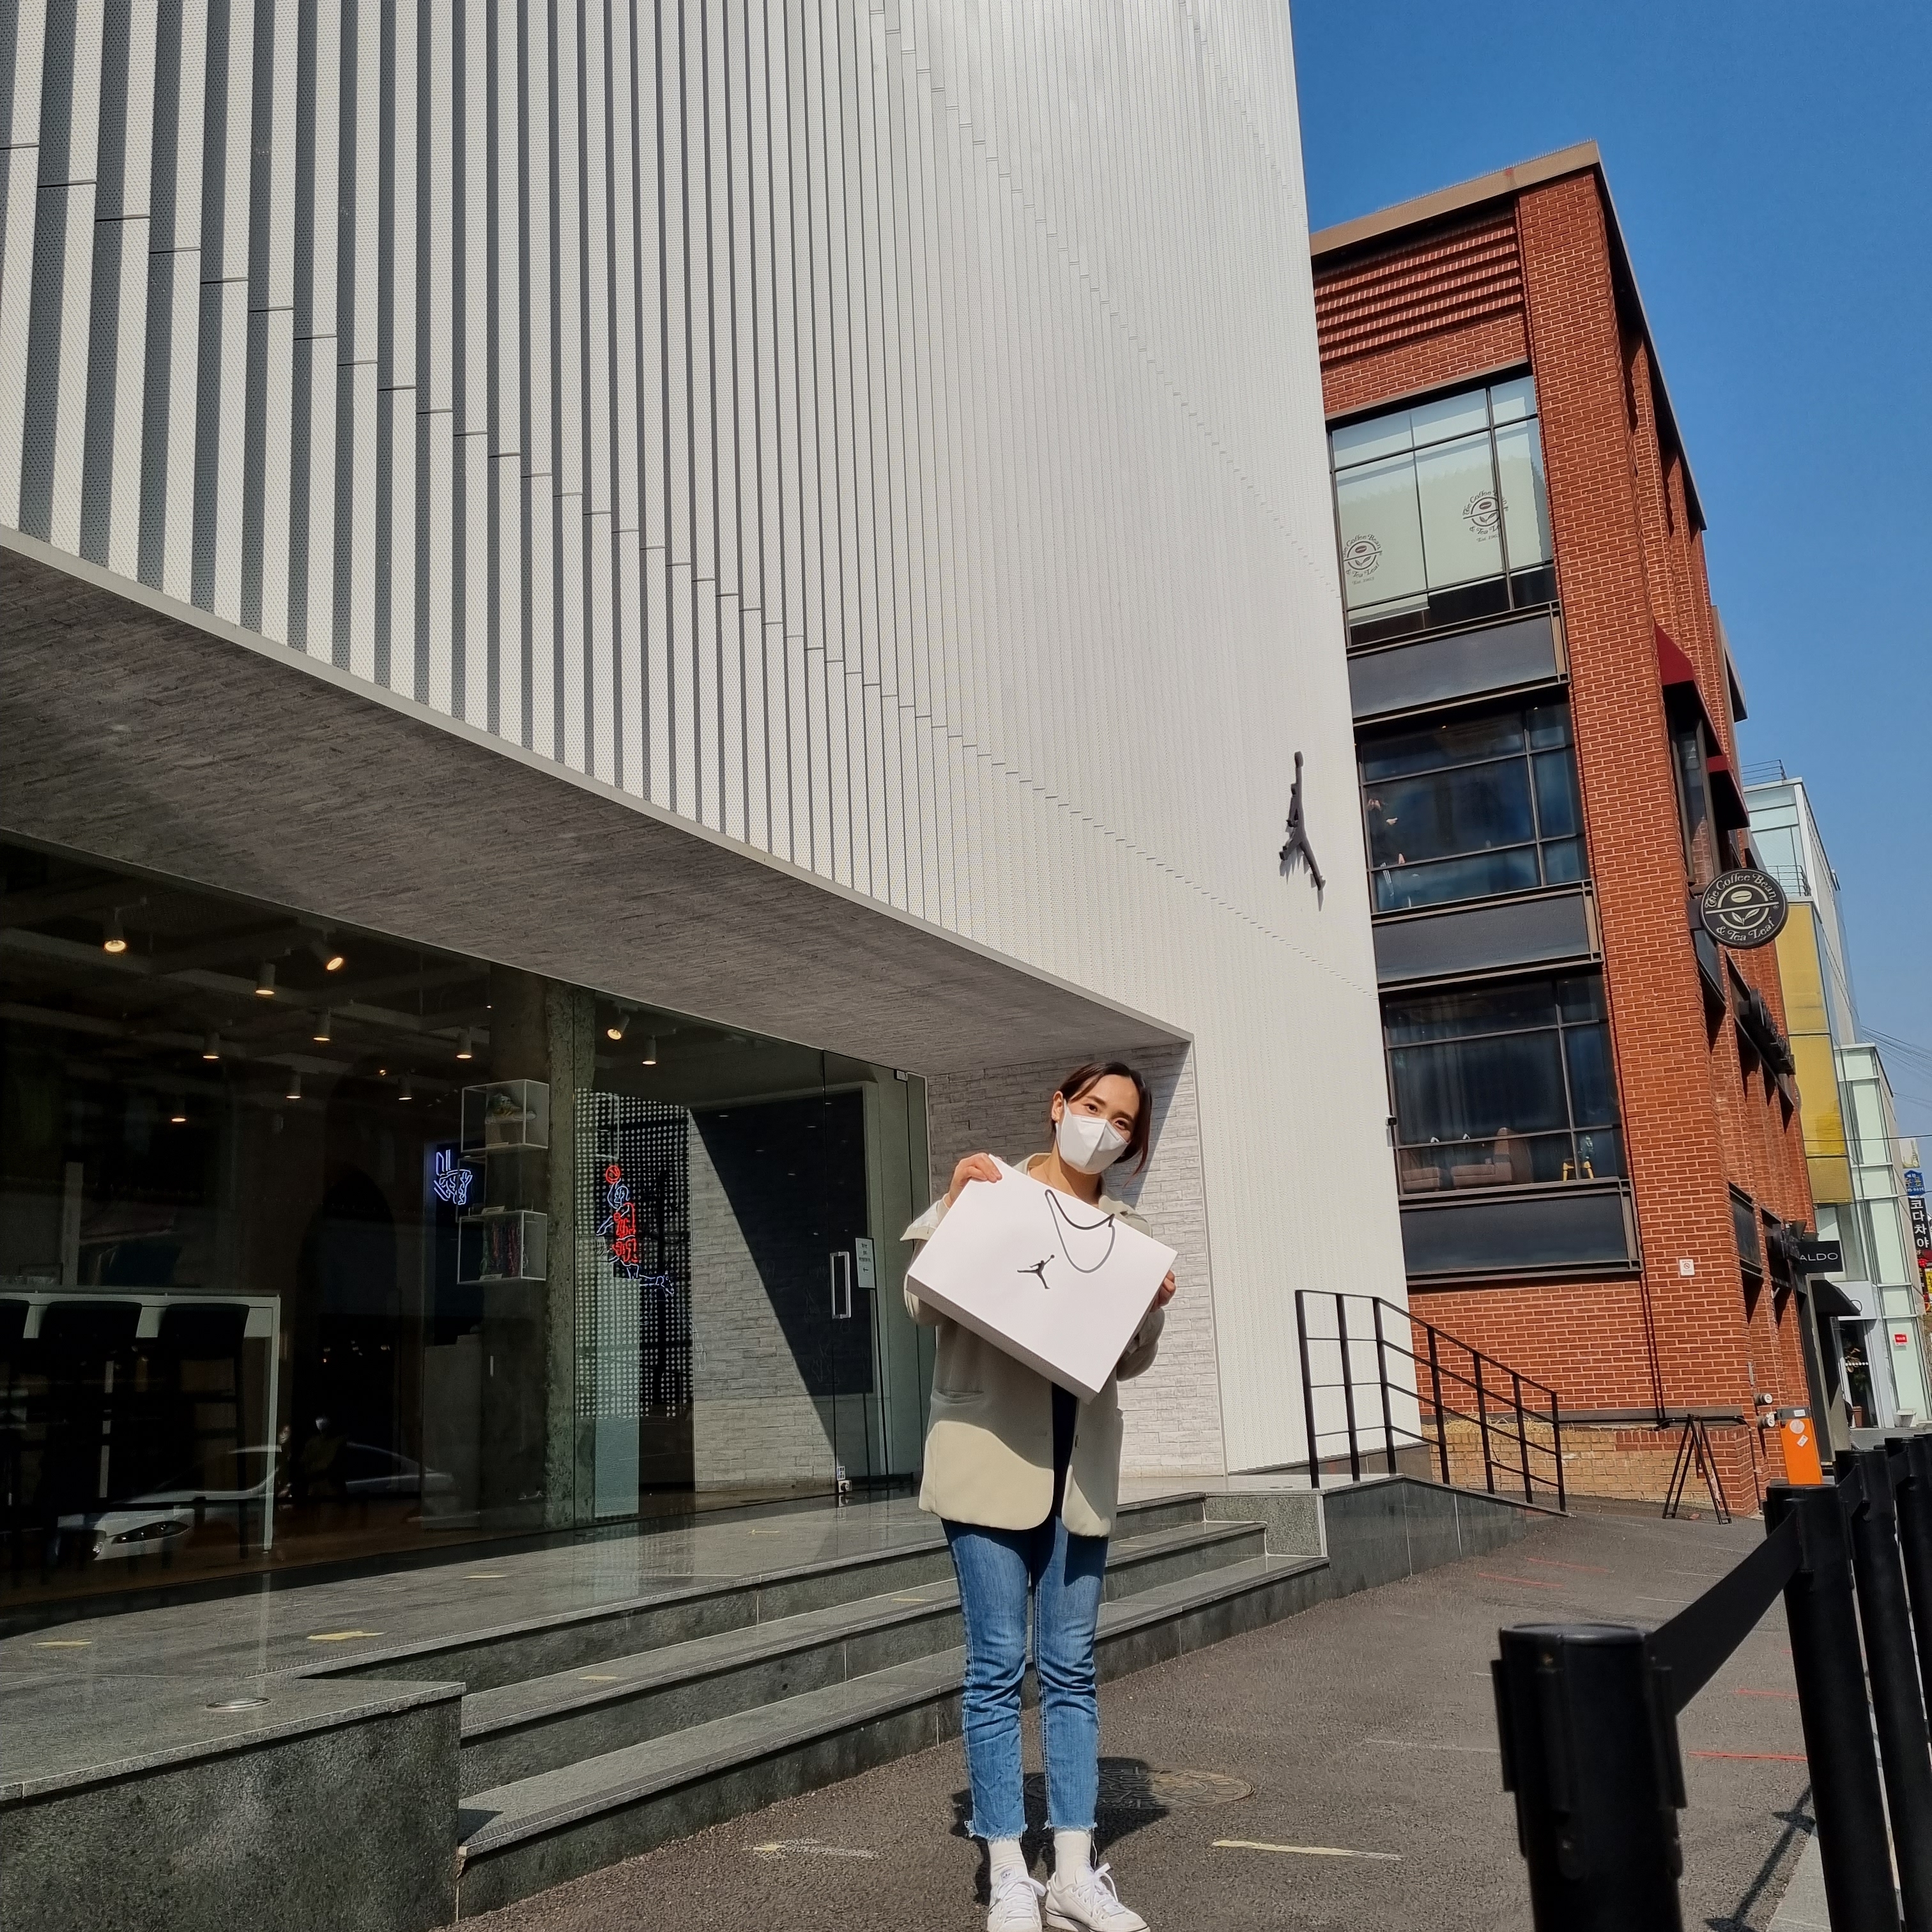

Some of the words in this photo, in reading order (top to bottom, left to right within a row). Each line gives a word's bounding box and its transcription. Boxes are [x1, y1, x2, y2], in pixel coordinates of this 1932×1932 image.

[1469, 490, 1491, 503] Coffee
[1346, 534, 1367, 547] Coffee
[1367, 534, 1381, 550] Bean
[1364, 560, 1379, 575] Leaf
[1705, 891, 1719, 908] The
[1716, 873, 1751, 891] Coffee
[1752, 873, 1777, 901] Bean
[1716, 926, 1725, 936] &
[1728, 930, 1747, 941] Tea
[1748, 916, 1775, 939] Leaf
[1911, 1200, 1929, 1248] 코다차야
[1800, 1252, 1838, 1261] ALDO
